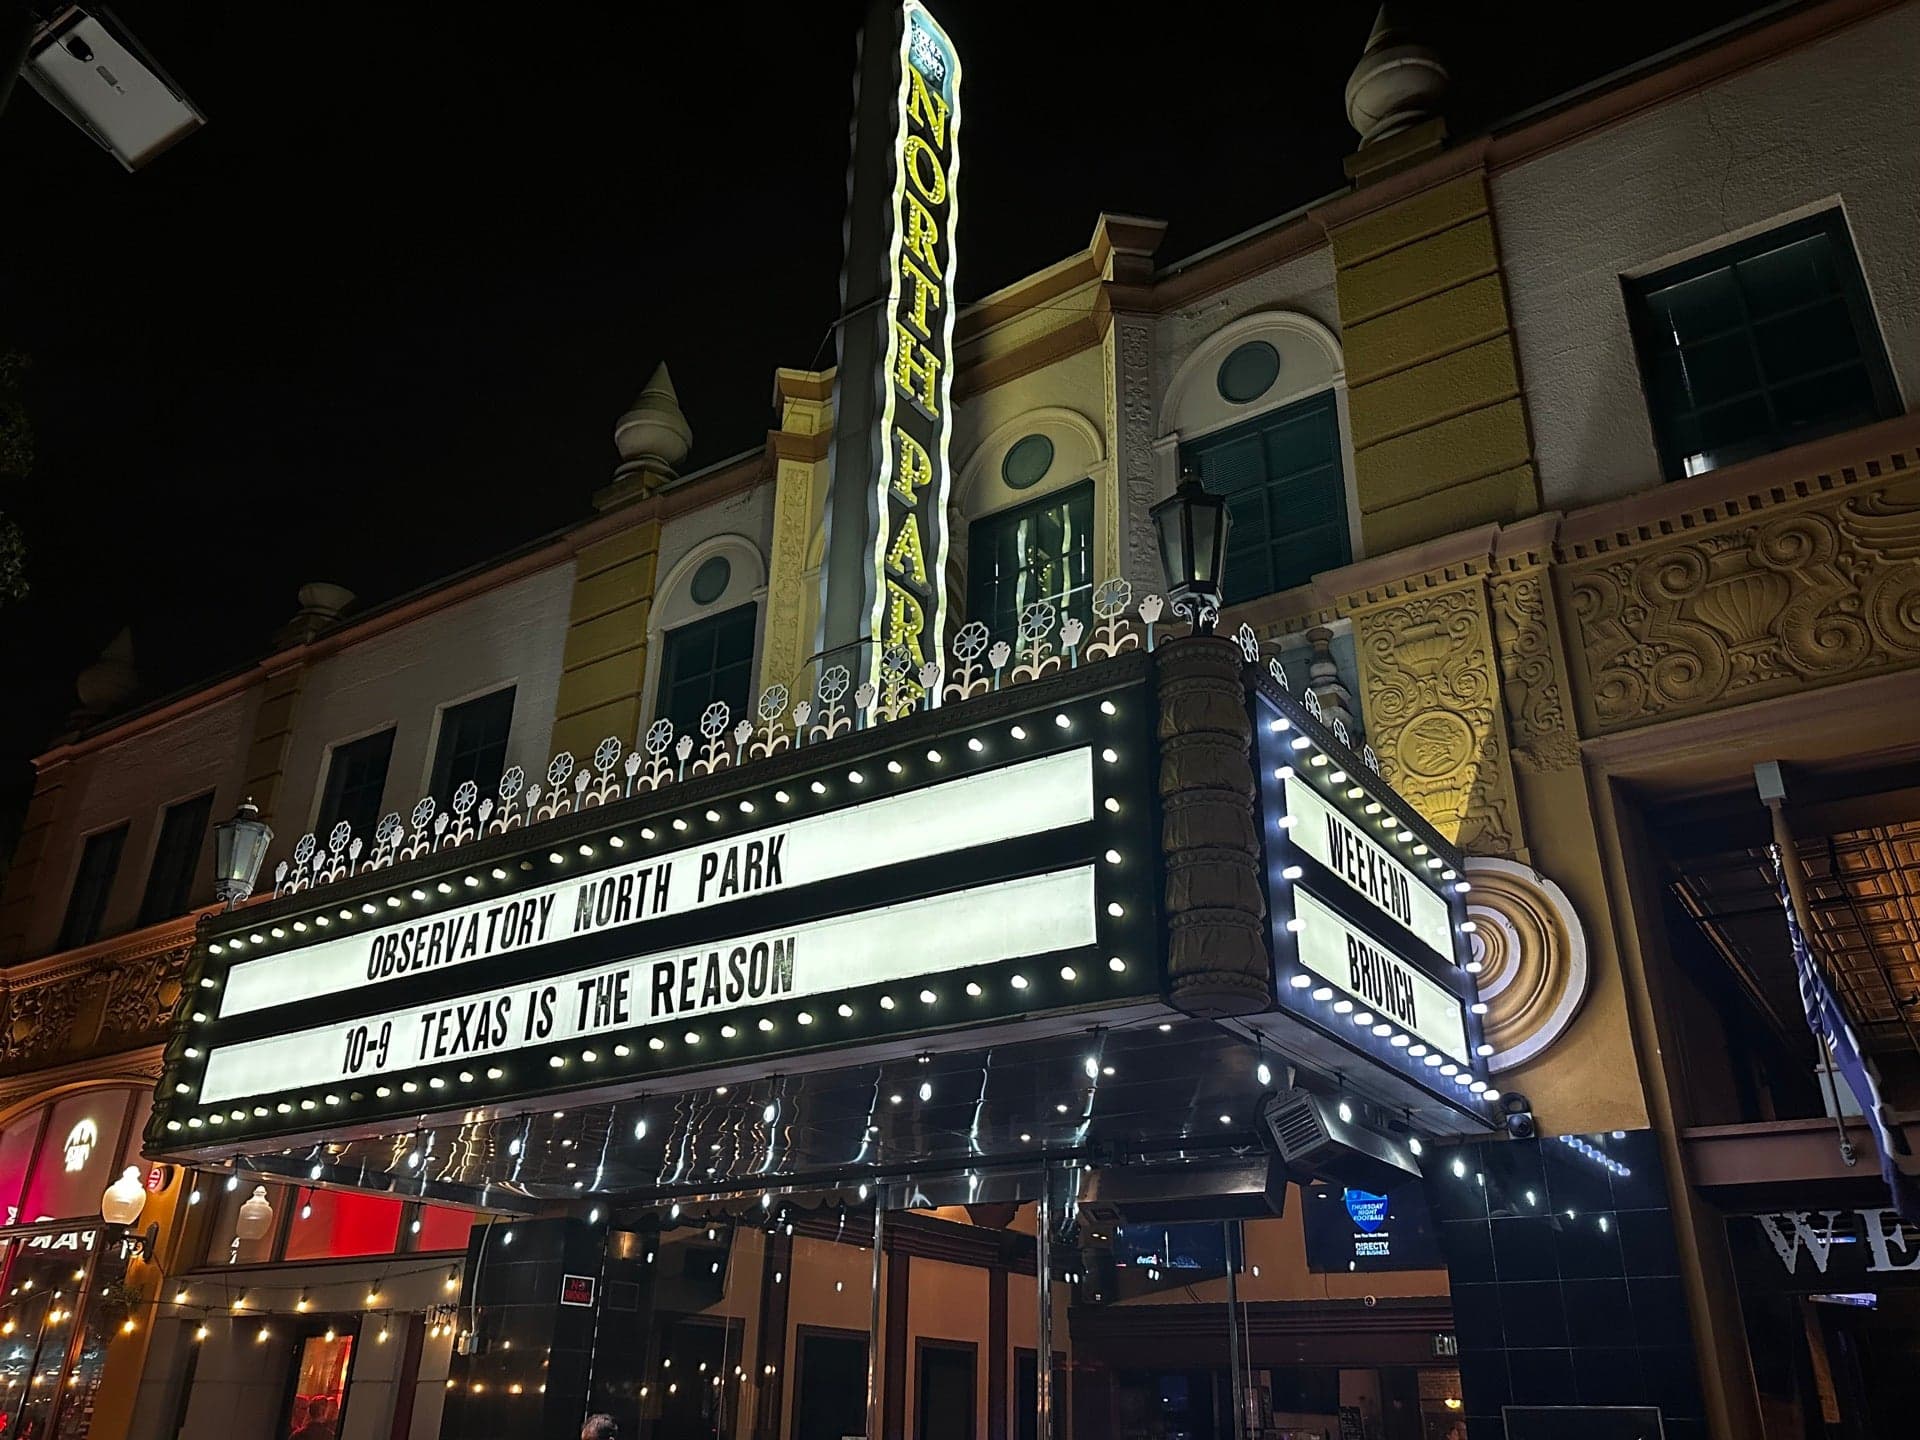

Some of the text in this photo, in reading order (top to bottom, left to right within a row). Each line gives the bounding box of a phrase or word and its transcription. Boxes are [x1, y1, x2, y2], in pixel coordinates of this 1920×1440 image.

[895, 63, 949, 418] NORTH
[367, 834, 787, 981] OBSERVATORY NORTH PARK
[1325, 812, 1413, 927] WEEKEND
[341, 937, 796, 1075] 10-9 TEXAS IS THE REASON
[1345, 932, 1418, 1030] BRUNCH
[1355, 1241, 1389, 1250] DIRECTV
